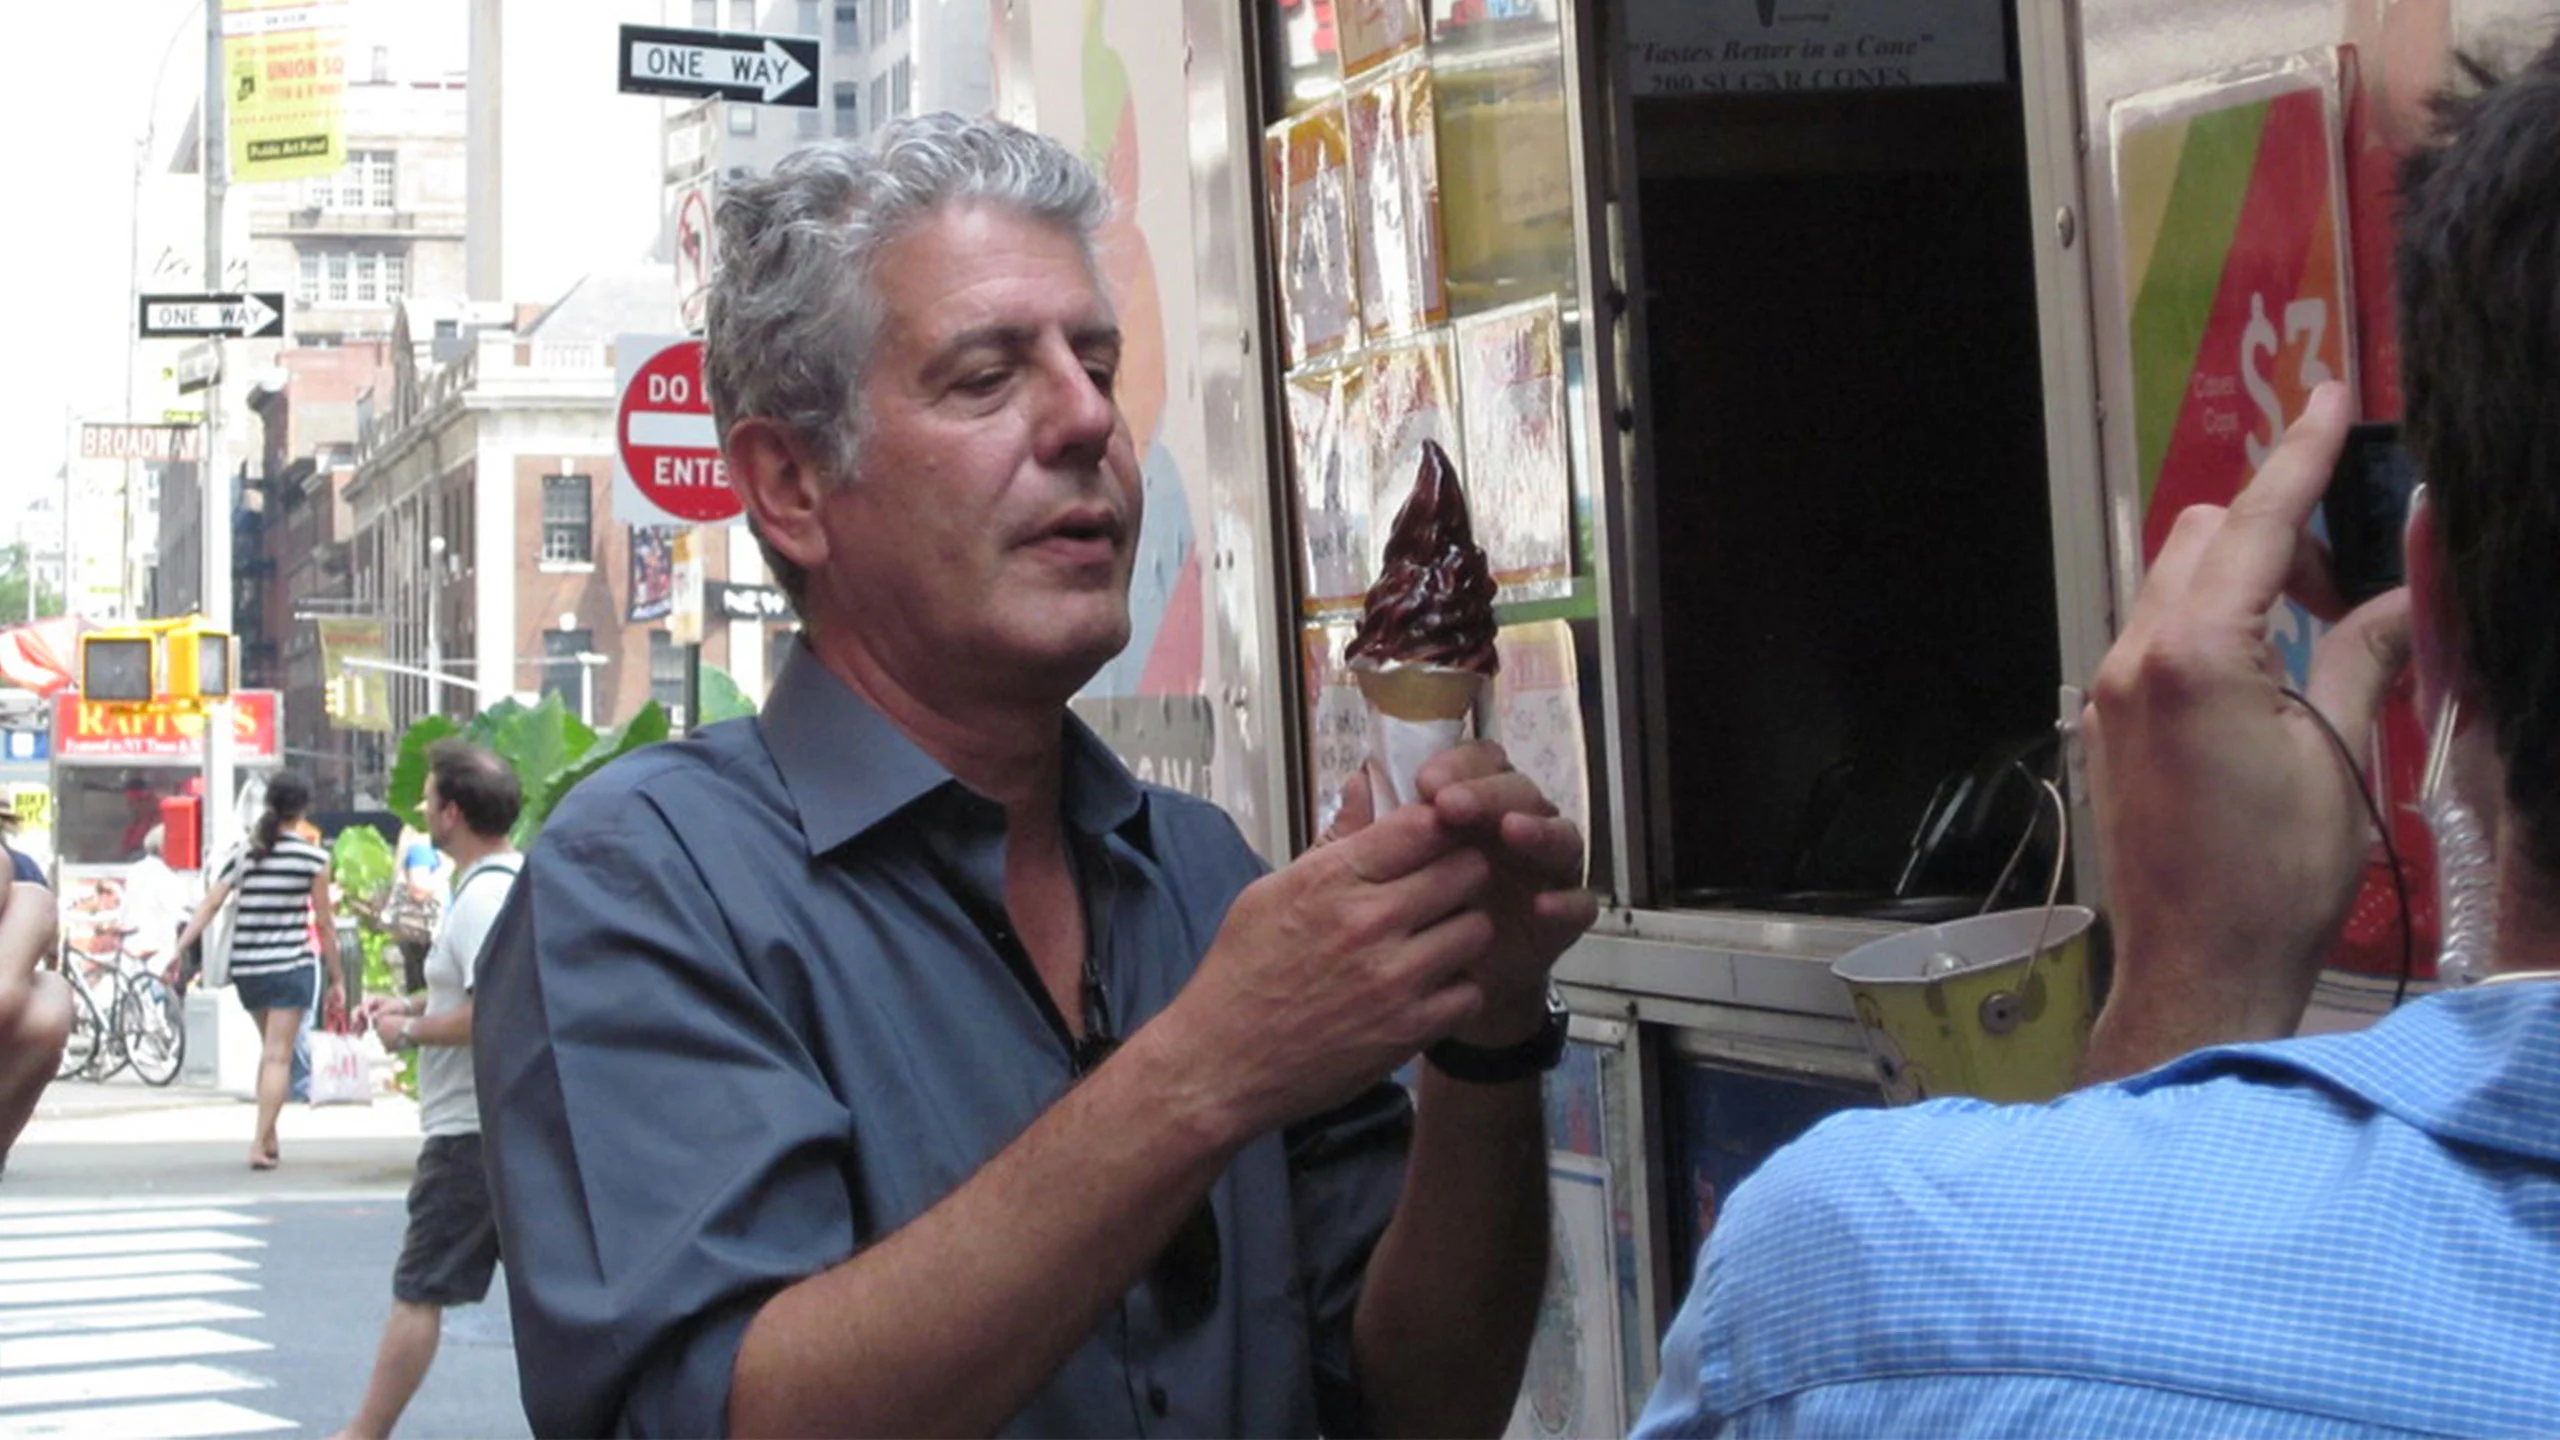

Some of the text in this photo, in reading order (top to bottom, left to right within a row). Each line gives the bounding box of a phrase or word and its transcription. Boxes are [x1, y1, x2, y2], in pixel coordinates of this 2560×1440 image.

[1721, 38, 1792, 62] Better
[1801, 36, 1828, 60] in
[1832, 43, 1848, 60] a
[267, 60, 318, 81] UNION
[647, 47, 790, 84] ONE WAY
[1702, 68, 1802, 93] SUGAR
[1810, 66, 1912, 89] CONES
[159, 305, 263, 326] ONE WAY
[648, 374, 690, 403] DO
[83, 428, 199, 459] BROADWAY
[654, 456, 730, 488] ENTE
[722, 589, 787, 616] NEW
